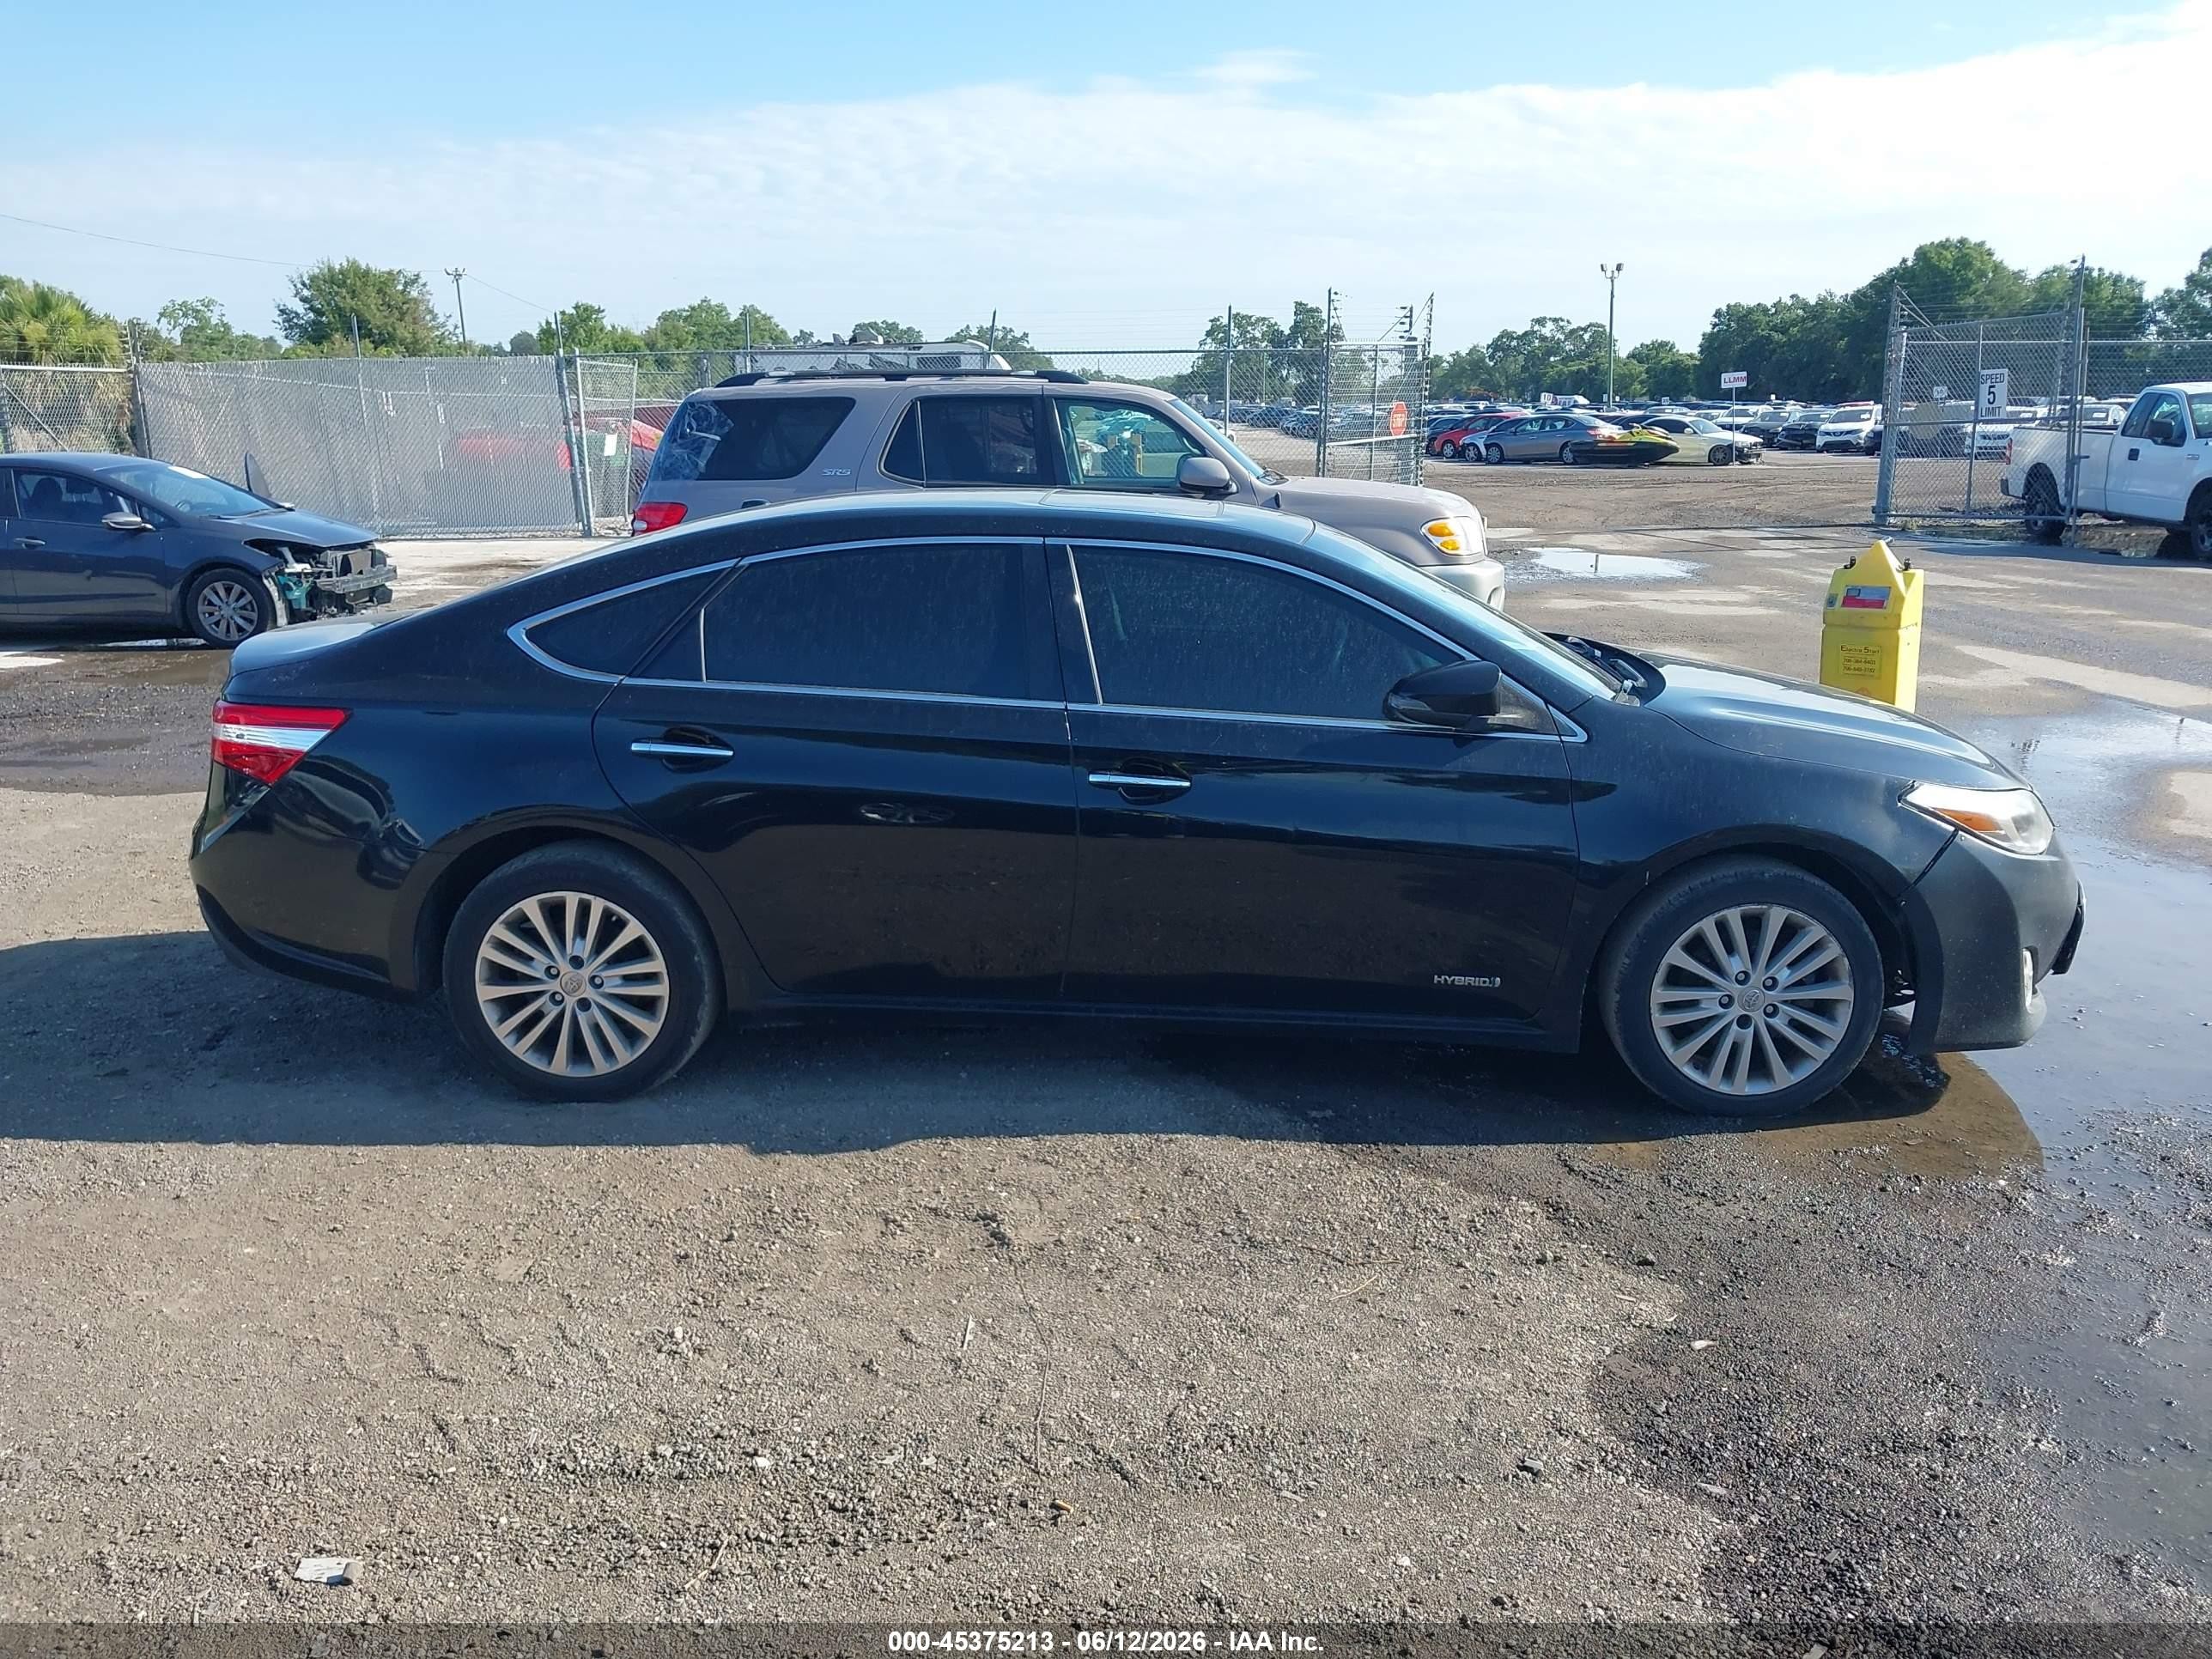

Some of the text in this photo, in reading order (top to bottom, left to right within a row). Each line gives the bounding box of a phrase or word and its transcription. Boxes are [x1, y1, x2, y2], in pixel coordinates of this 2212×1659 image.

[1980, 373, 2005, 385] SPEED
[1987, 385, 1996, 405] 5
[1980, 406, 2002, 417] LIMIT
[1433, 975, 1492, 987] HYBRID
